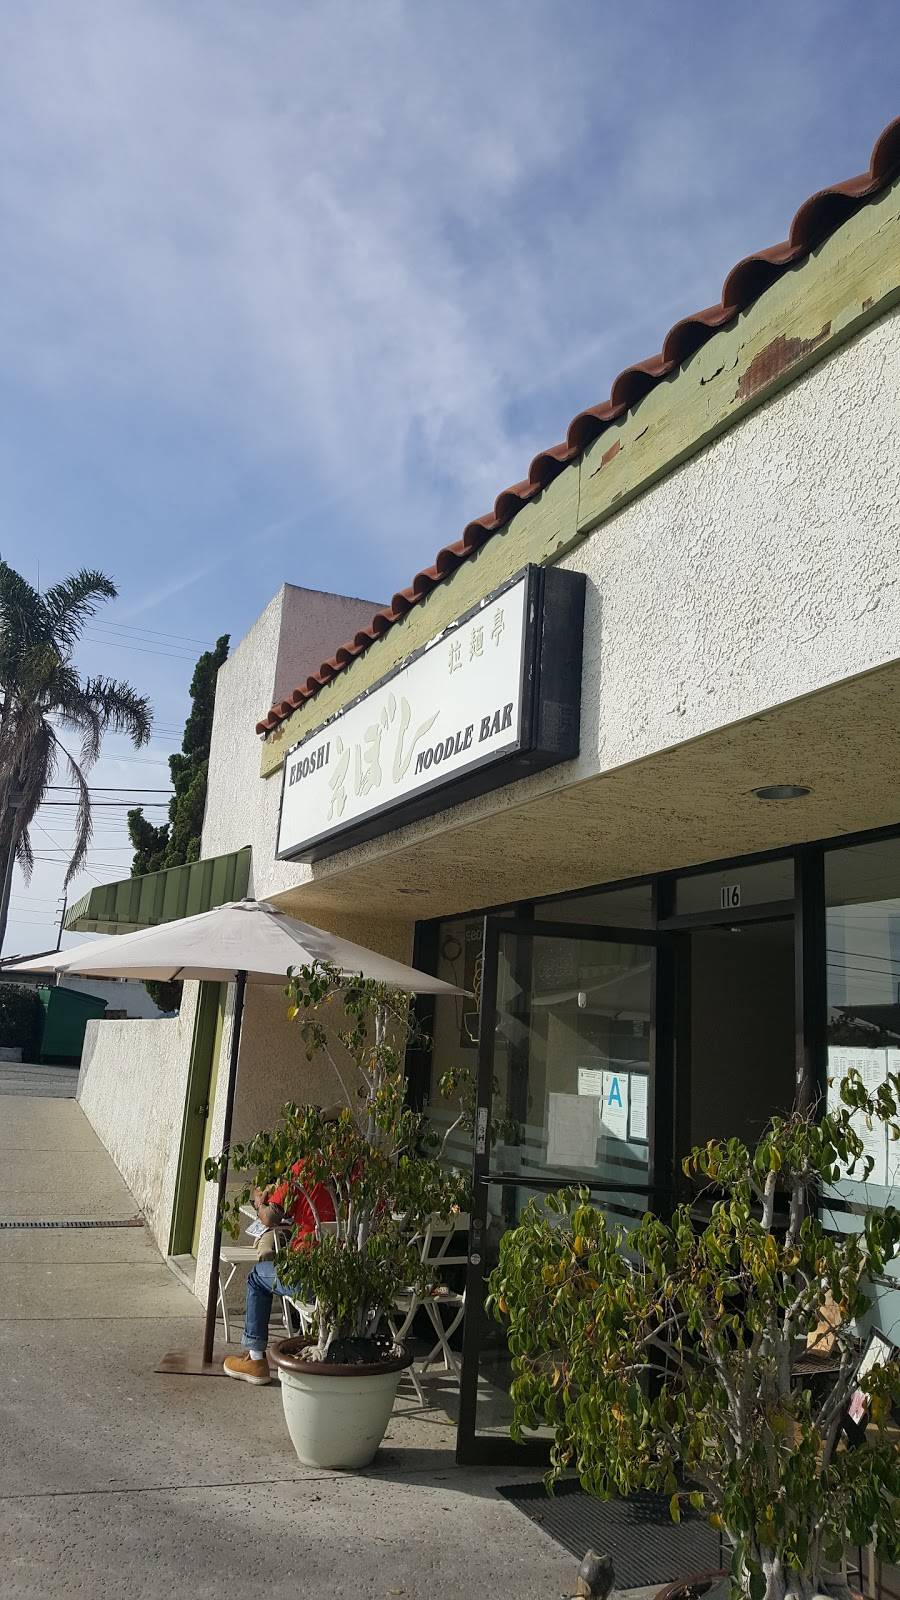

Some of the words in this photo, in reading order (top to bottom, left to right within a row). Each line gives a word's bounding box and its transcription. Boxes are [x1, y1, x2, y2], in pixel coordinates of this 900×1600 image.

[414, 724, 474, 775] NOODLE
[478, 702, 514, 742] BAR
[289, 741, 330, 787] EBOSHI
[722, 886, 739, 908] 116
[608, 1077, 622, 1108] A
